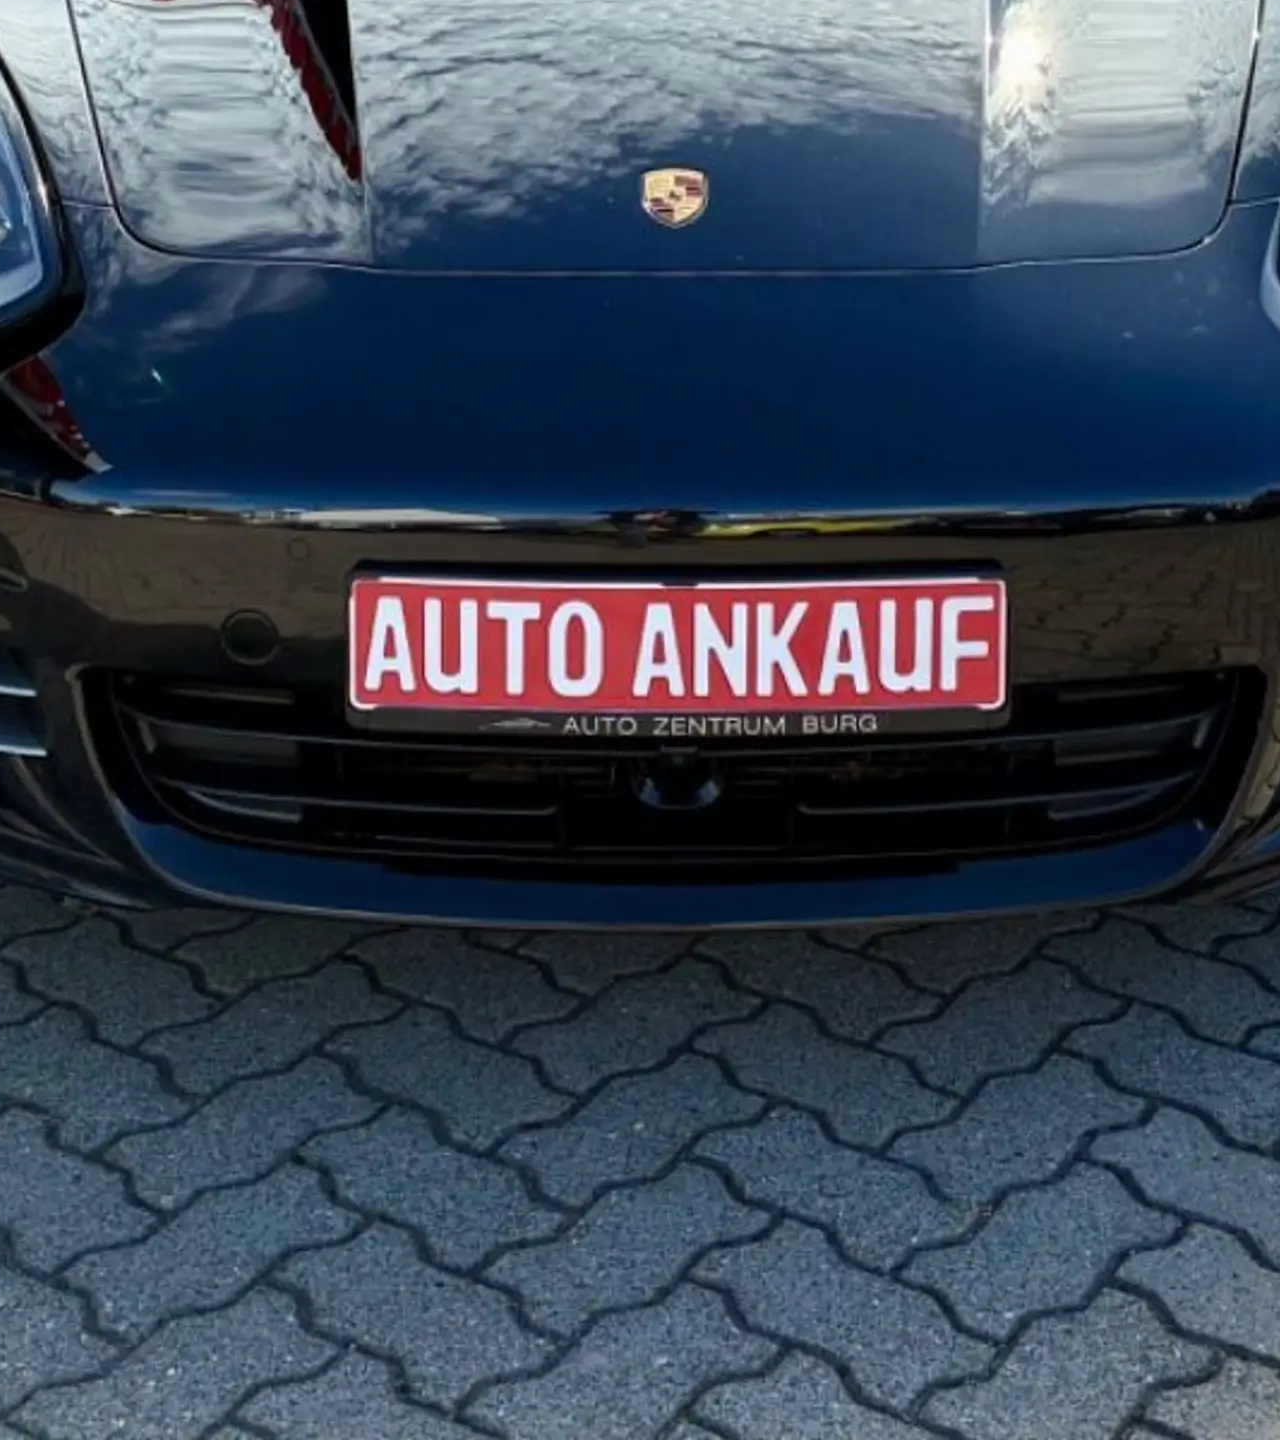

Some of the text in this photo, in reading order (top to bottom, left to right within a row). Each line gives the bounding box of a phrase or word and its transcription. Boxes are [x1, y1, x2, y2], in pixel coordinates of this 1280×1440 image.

[364, 595, 995, 698] AUTO ANKAUF
[562, 714, 878, 735] AUTO ZENTRUM BURG
